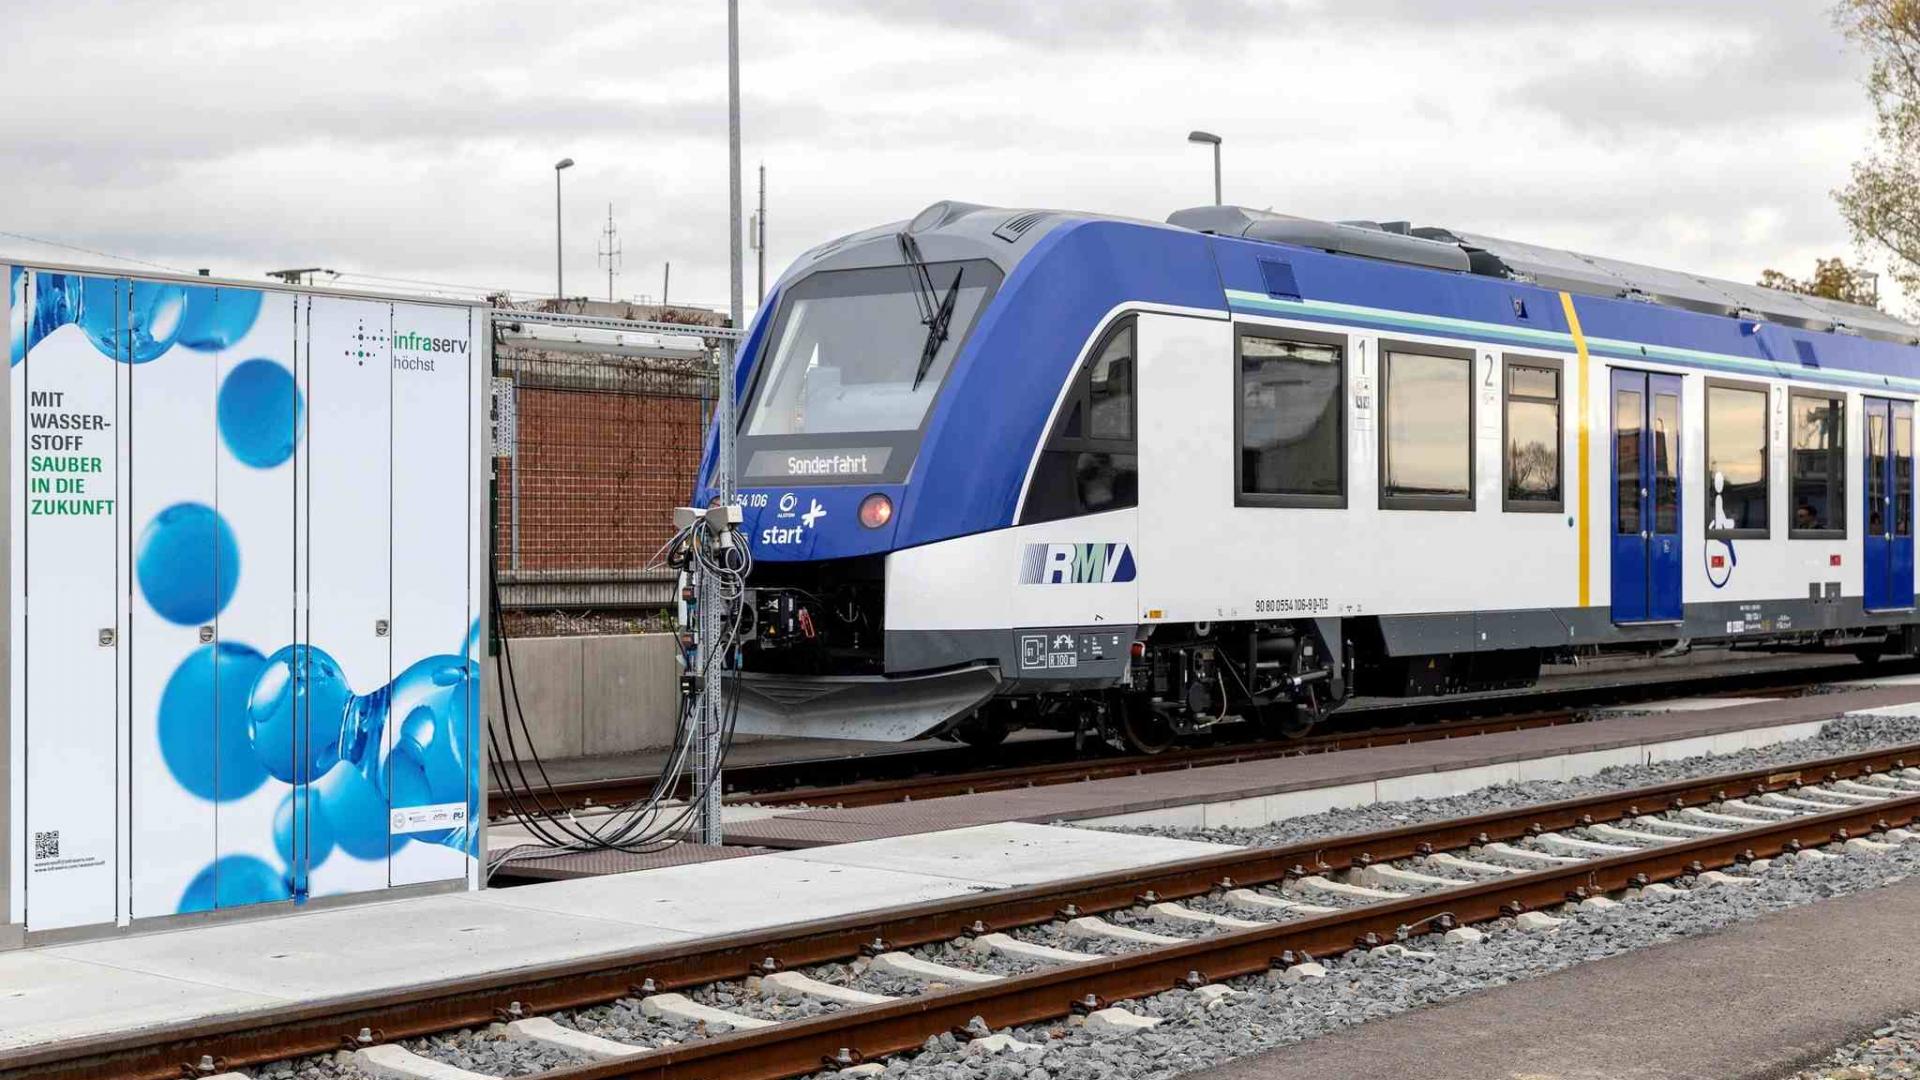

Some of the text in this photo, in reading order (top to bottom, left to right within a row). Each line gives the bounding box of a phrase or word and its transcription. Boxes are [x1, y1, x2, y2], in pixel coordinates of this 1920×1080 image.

[393, 330, 468, 354] infraserv
[393, 355, 435, 372] höchst
[1358, 339, 1366, 376] 1
[1484, 354, 1494, 387] 2
[31, 391, 64, 407] MIT
[30, 412, 111, 430] WASSER-
[31, 434, 83, 451] STOFF
[31, 456, 102, 473] SAUBER
[788, 454, 868, 474] Sonderfahrt
[31, 478, 85, 494] IN DIE
[31, 499, 115, 515] ZUKUNFT
[750, 493, 768, 508] 106
[762, 525, 804, 545] start
[1038, 542, 1130, 584] RMV
[1255, 599, 1265, 612] 90
[1265, 599, 1275, 612] 80
[1275, 599, 1293, 612] 0554
[1057, 654, 1068, 665] 100
